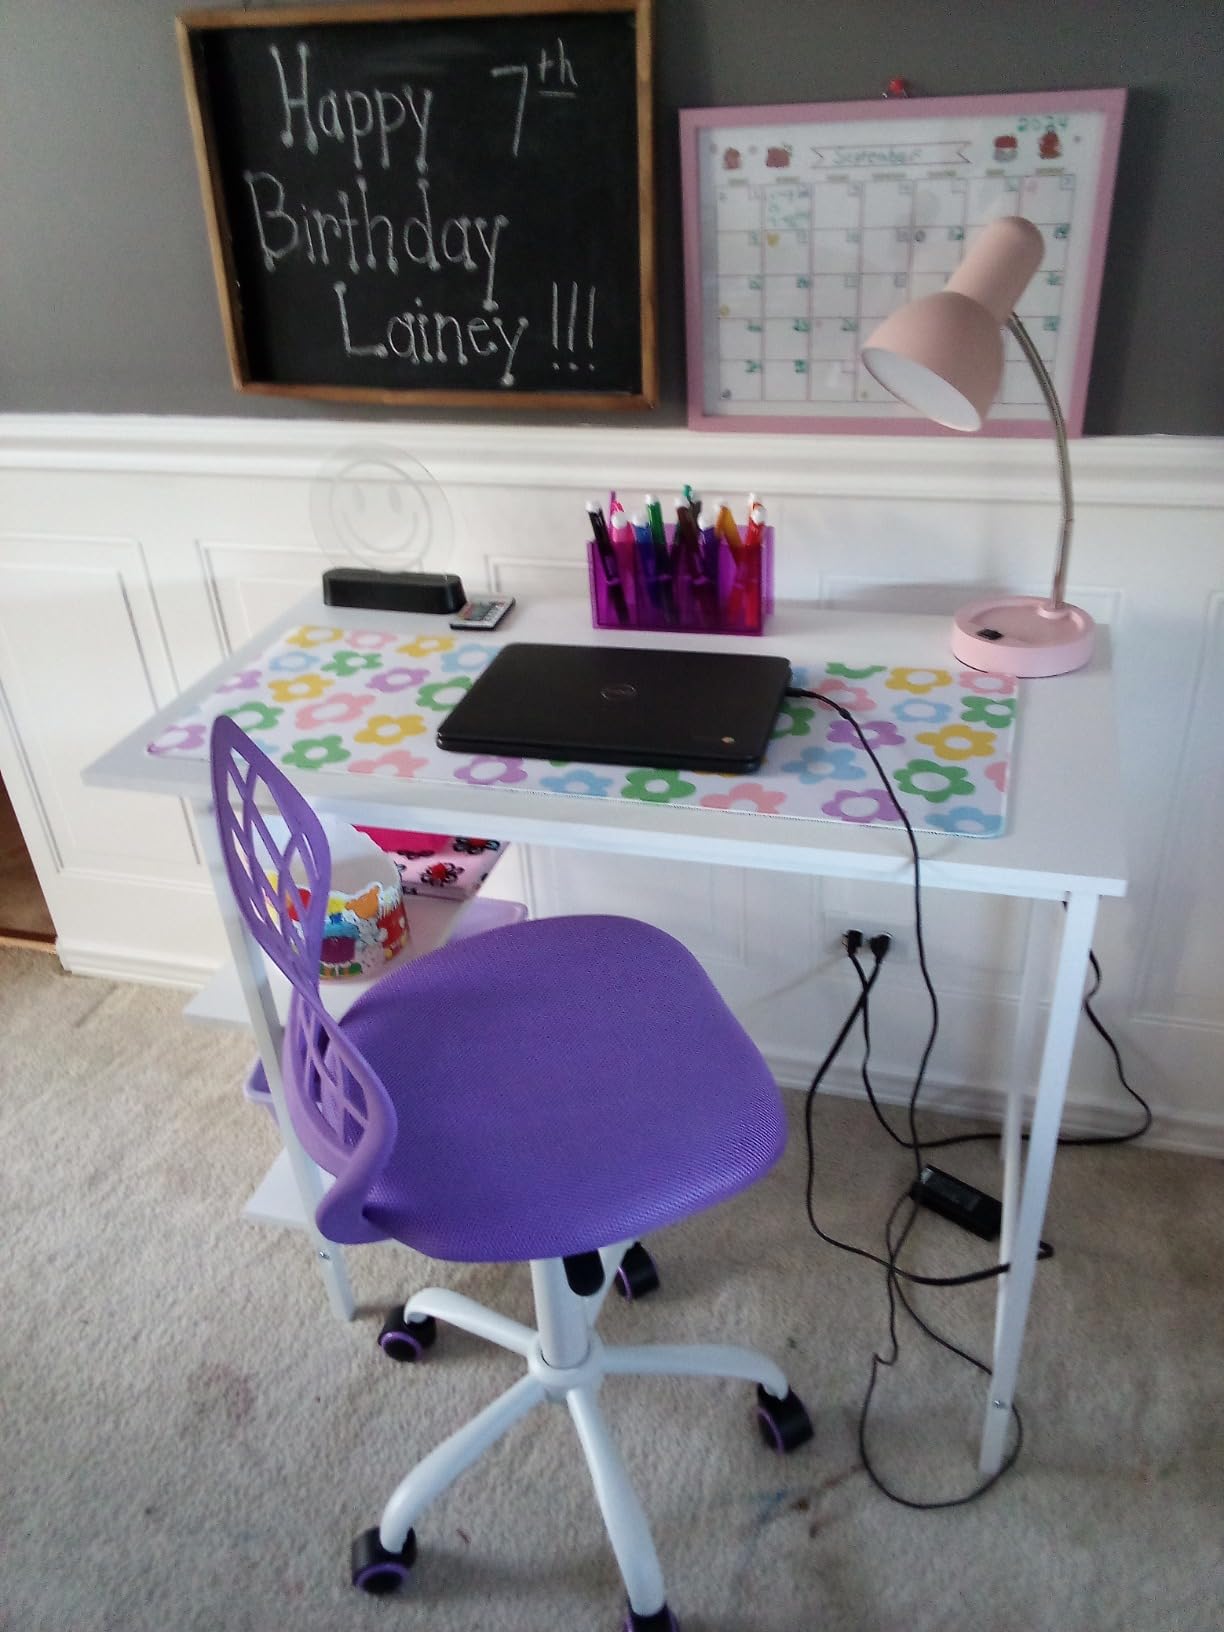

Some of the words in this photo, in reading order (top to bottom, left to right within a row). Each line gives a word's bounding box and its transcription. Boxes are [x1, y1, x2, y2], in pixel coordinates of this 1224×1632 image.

[269, 42, 434, 173] Happy
[490, 38, 579, 157] 7th
[243, 171, 510, 313] Birthday
[334, 281, 529, 387] Lainey
